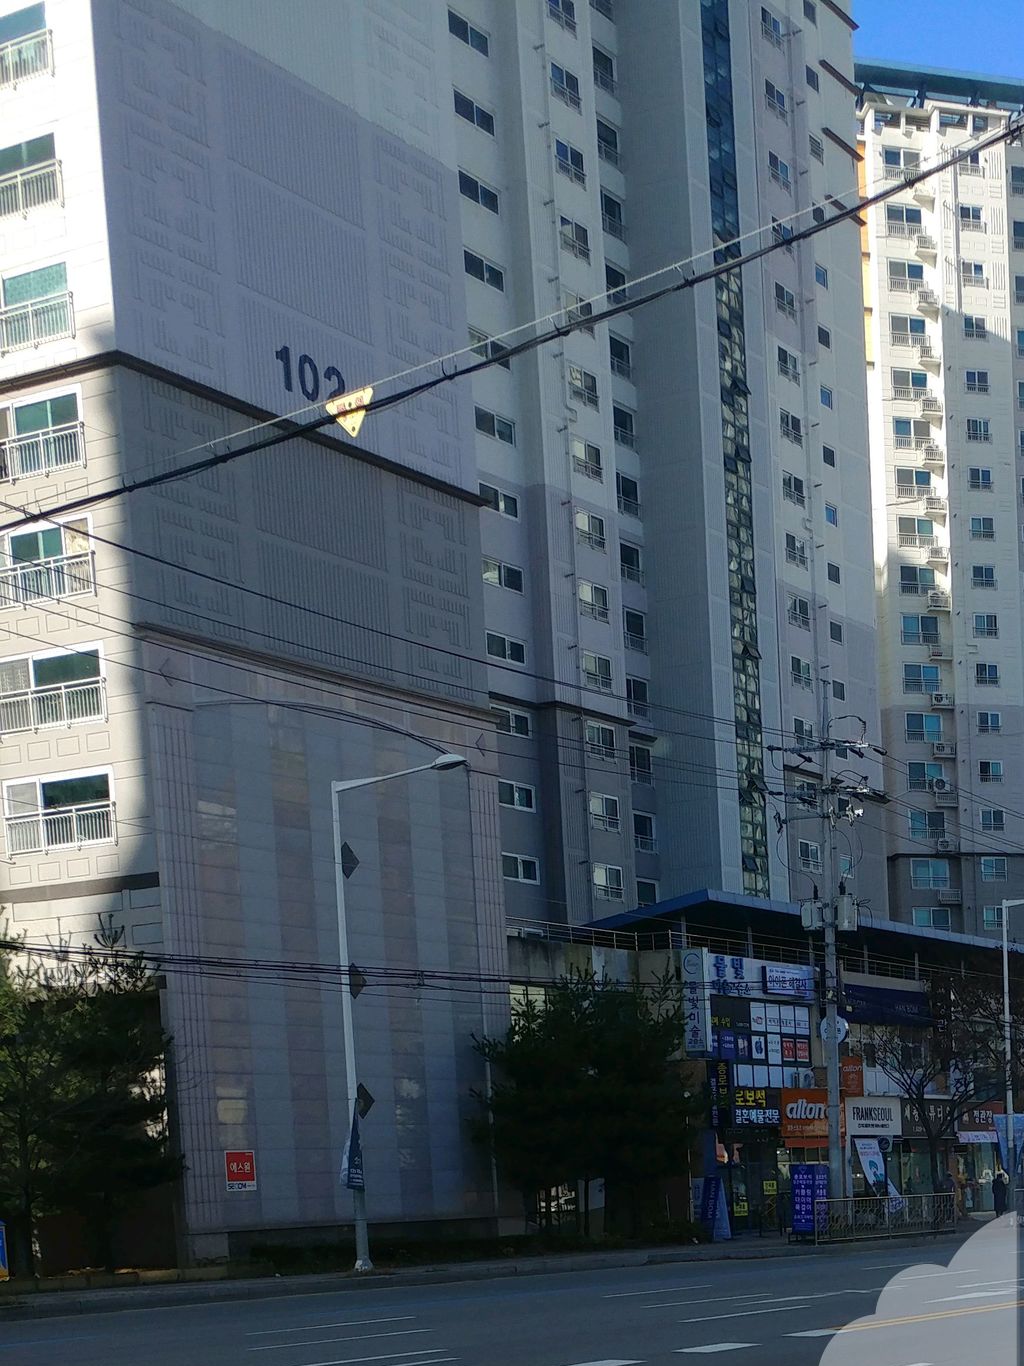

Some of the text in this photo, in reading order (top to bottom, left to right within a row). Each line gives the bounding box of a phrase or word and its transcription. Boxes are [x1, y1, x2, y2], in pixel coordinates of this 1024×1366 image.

[785, 1098, 826, 1120] alton
[852, 1106, 894, 1122] FRANKSEOUL
[972, 1109, 993, 1124] 정관장
[230, 1162, 251, 1173] 에스원
